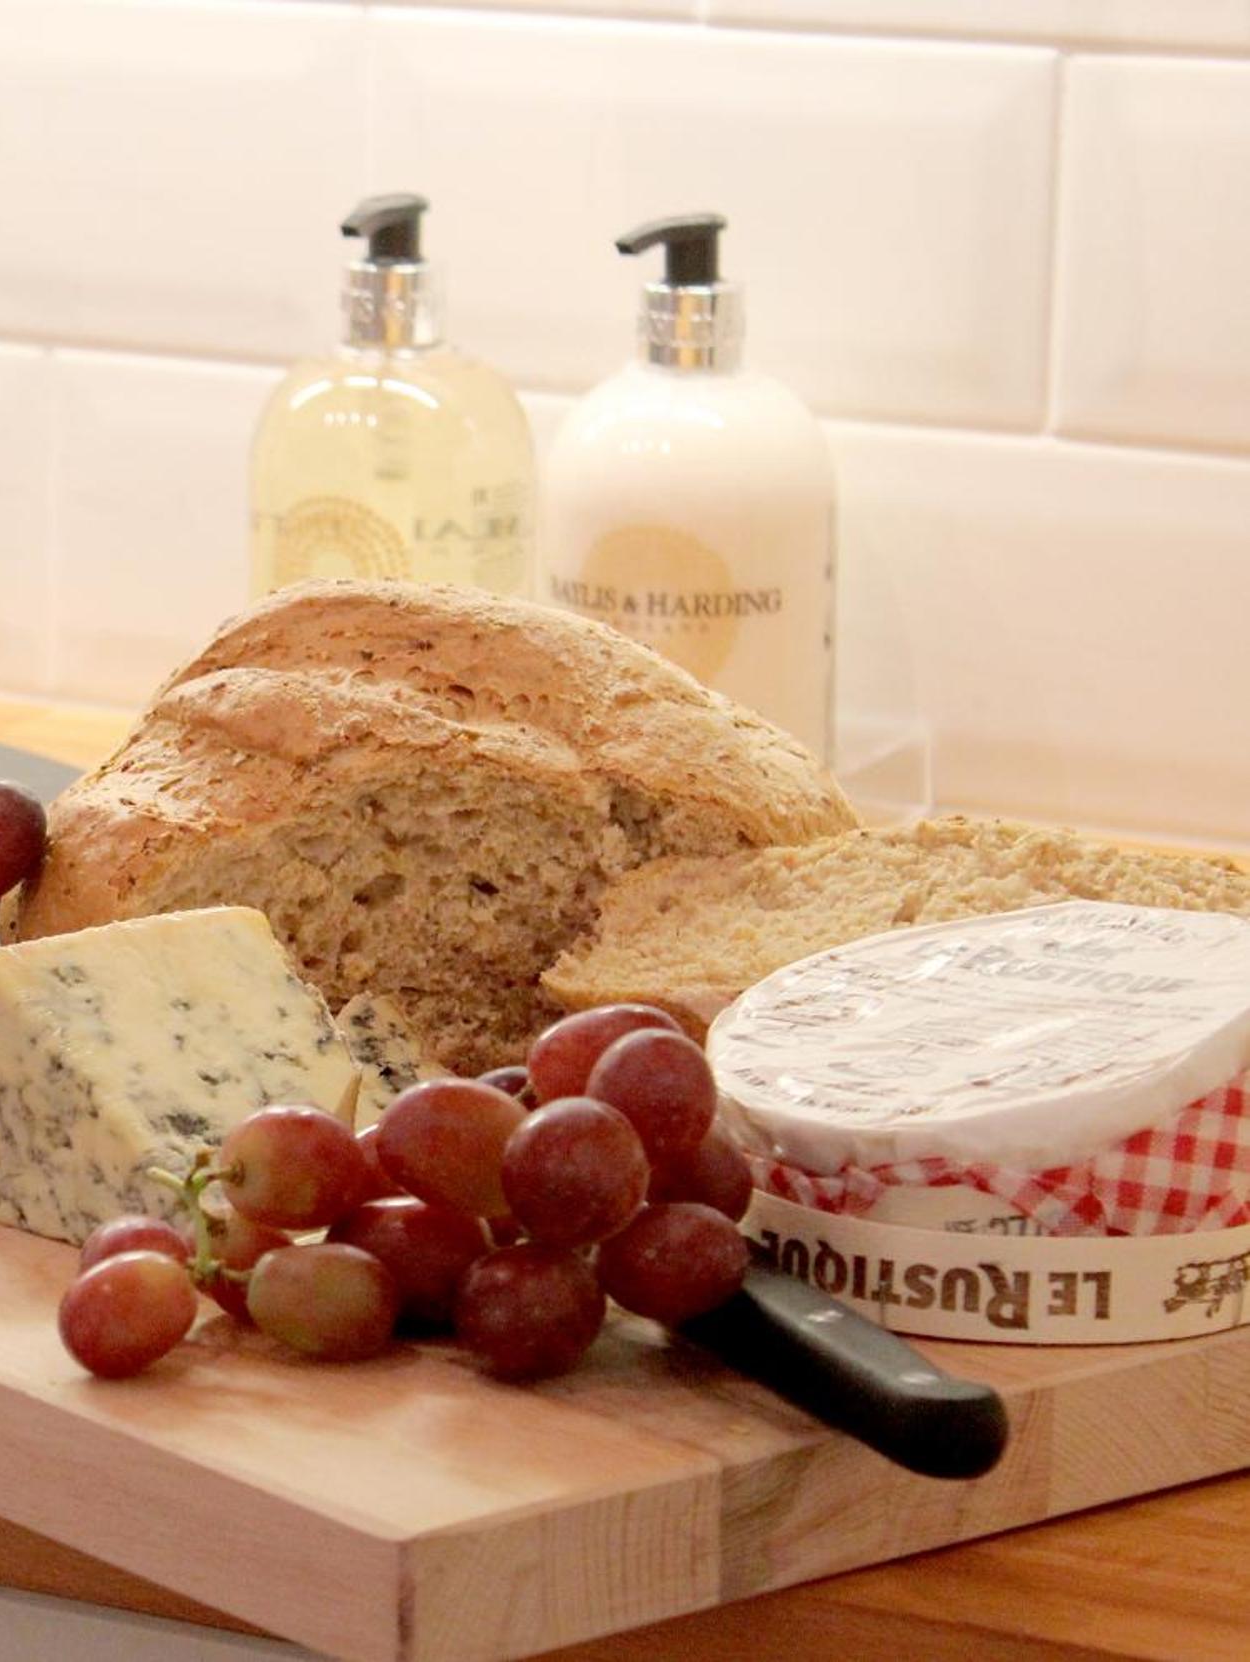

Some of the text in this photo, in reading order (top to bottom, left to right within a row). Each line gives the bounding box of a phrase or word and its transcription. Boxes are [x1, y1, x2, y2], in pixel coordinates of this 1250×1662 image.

[622, 593, 638, 615] &
[647, 587, 782, 618] HARDING
[1048, 1270, 1111, 1321] LE
